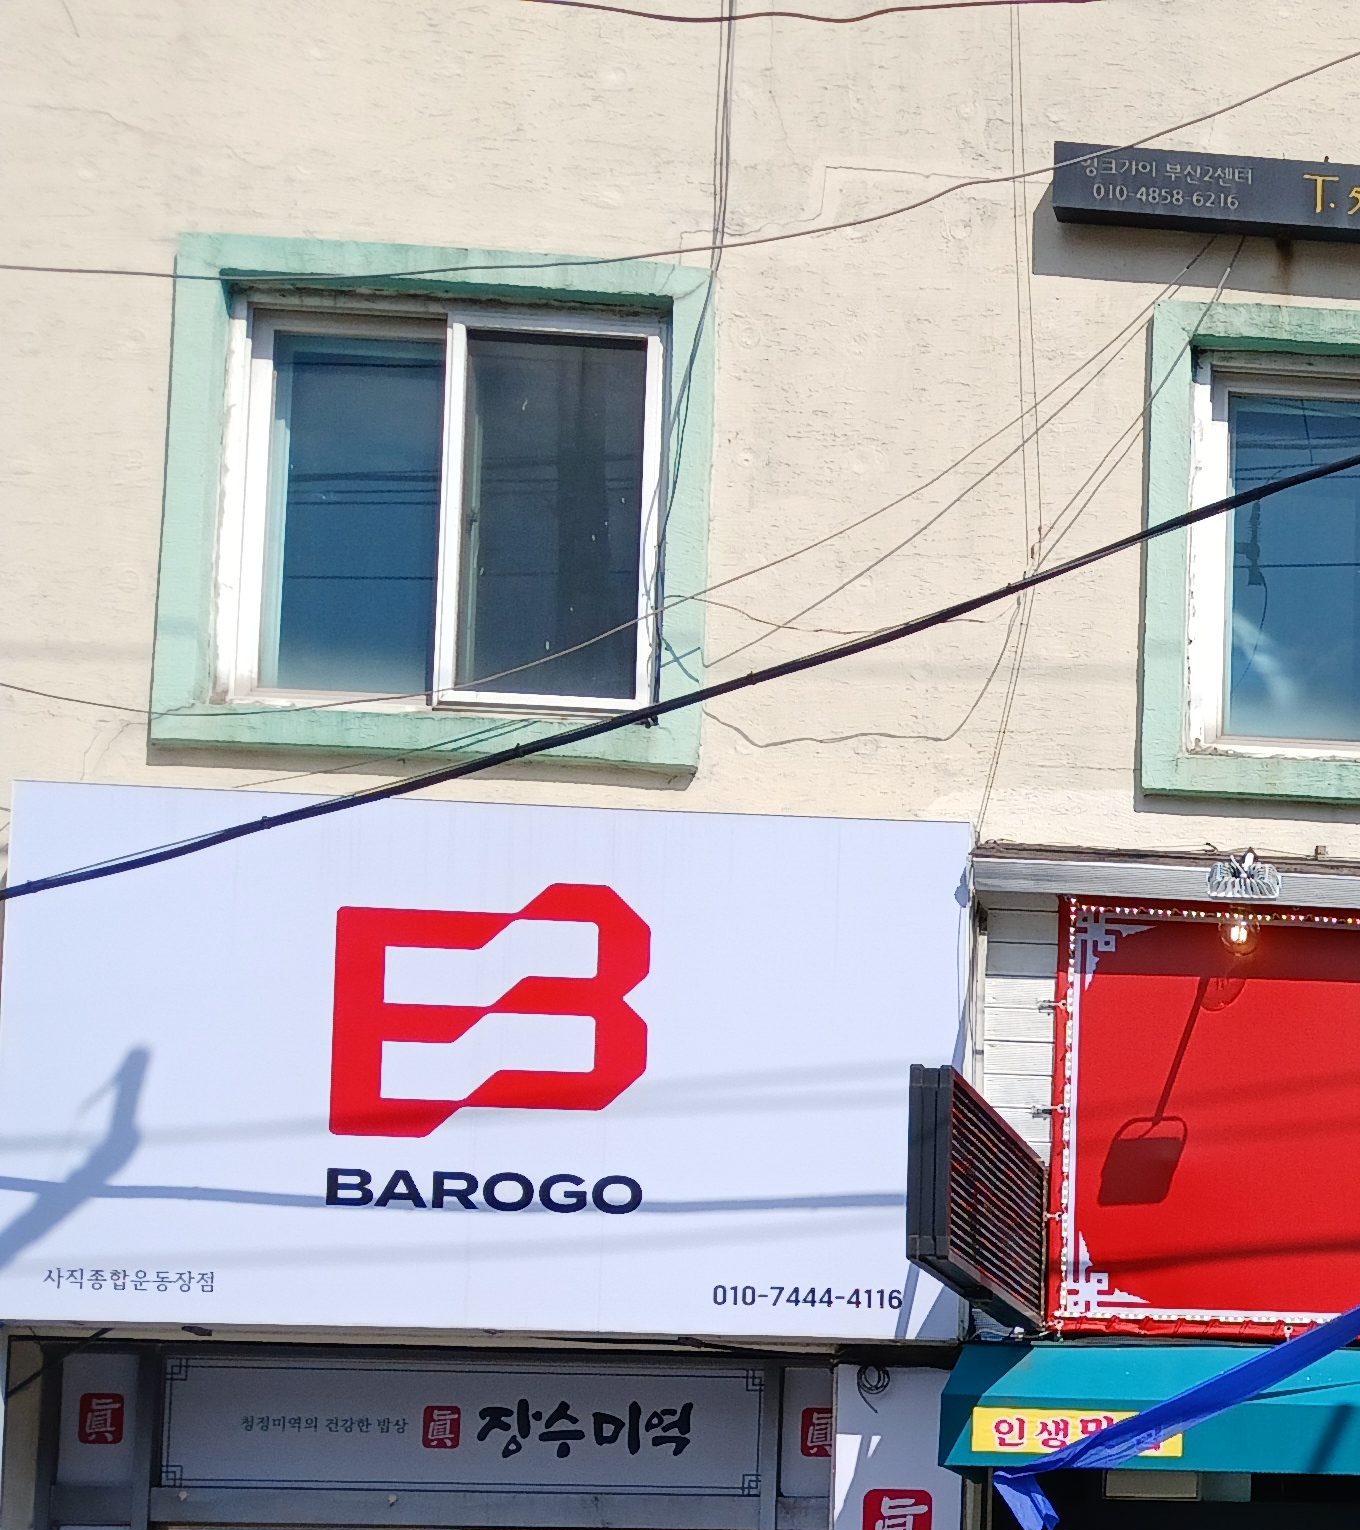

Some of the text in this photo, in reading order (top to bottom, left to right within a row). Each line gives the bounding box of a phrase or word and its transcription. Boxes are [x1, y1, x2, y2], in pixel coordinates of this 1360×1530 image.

[1163, 162, 1253, 186] 부산2센터
[1092, 182, 1240, 210] 010-4858-6216
[325, 1167, 643, 1215] BAROGO
[43, 1267, 217, 1296] 사직종합운동장점
[712, 1282, 905, 1312] 010-7444-4116
[324, 1416, 372, 1435] 건강한
[376, 1417, 409, 1436] 밥상
[475, 1397, 695, 1459] 장수미역
